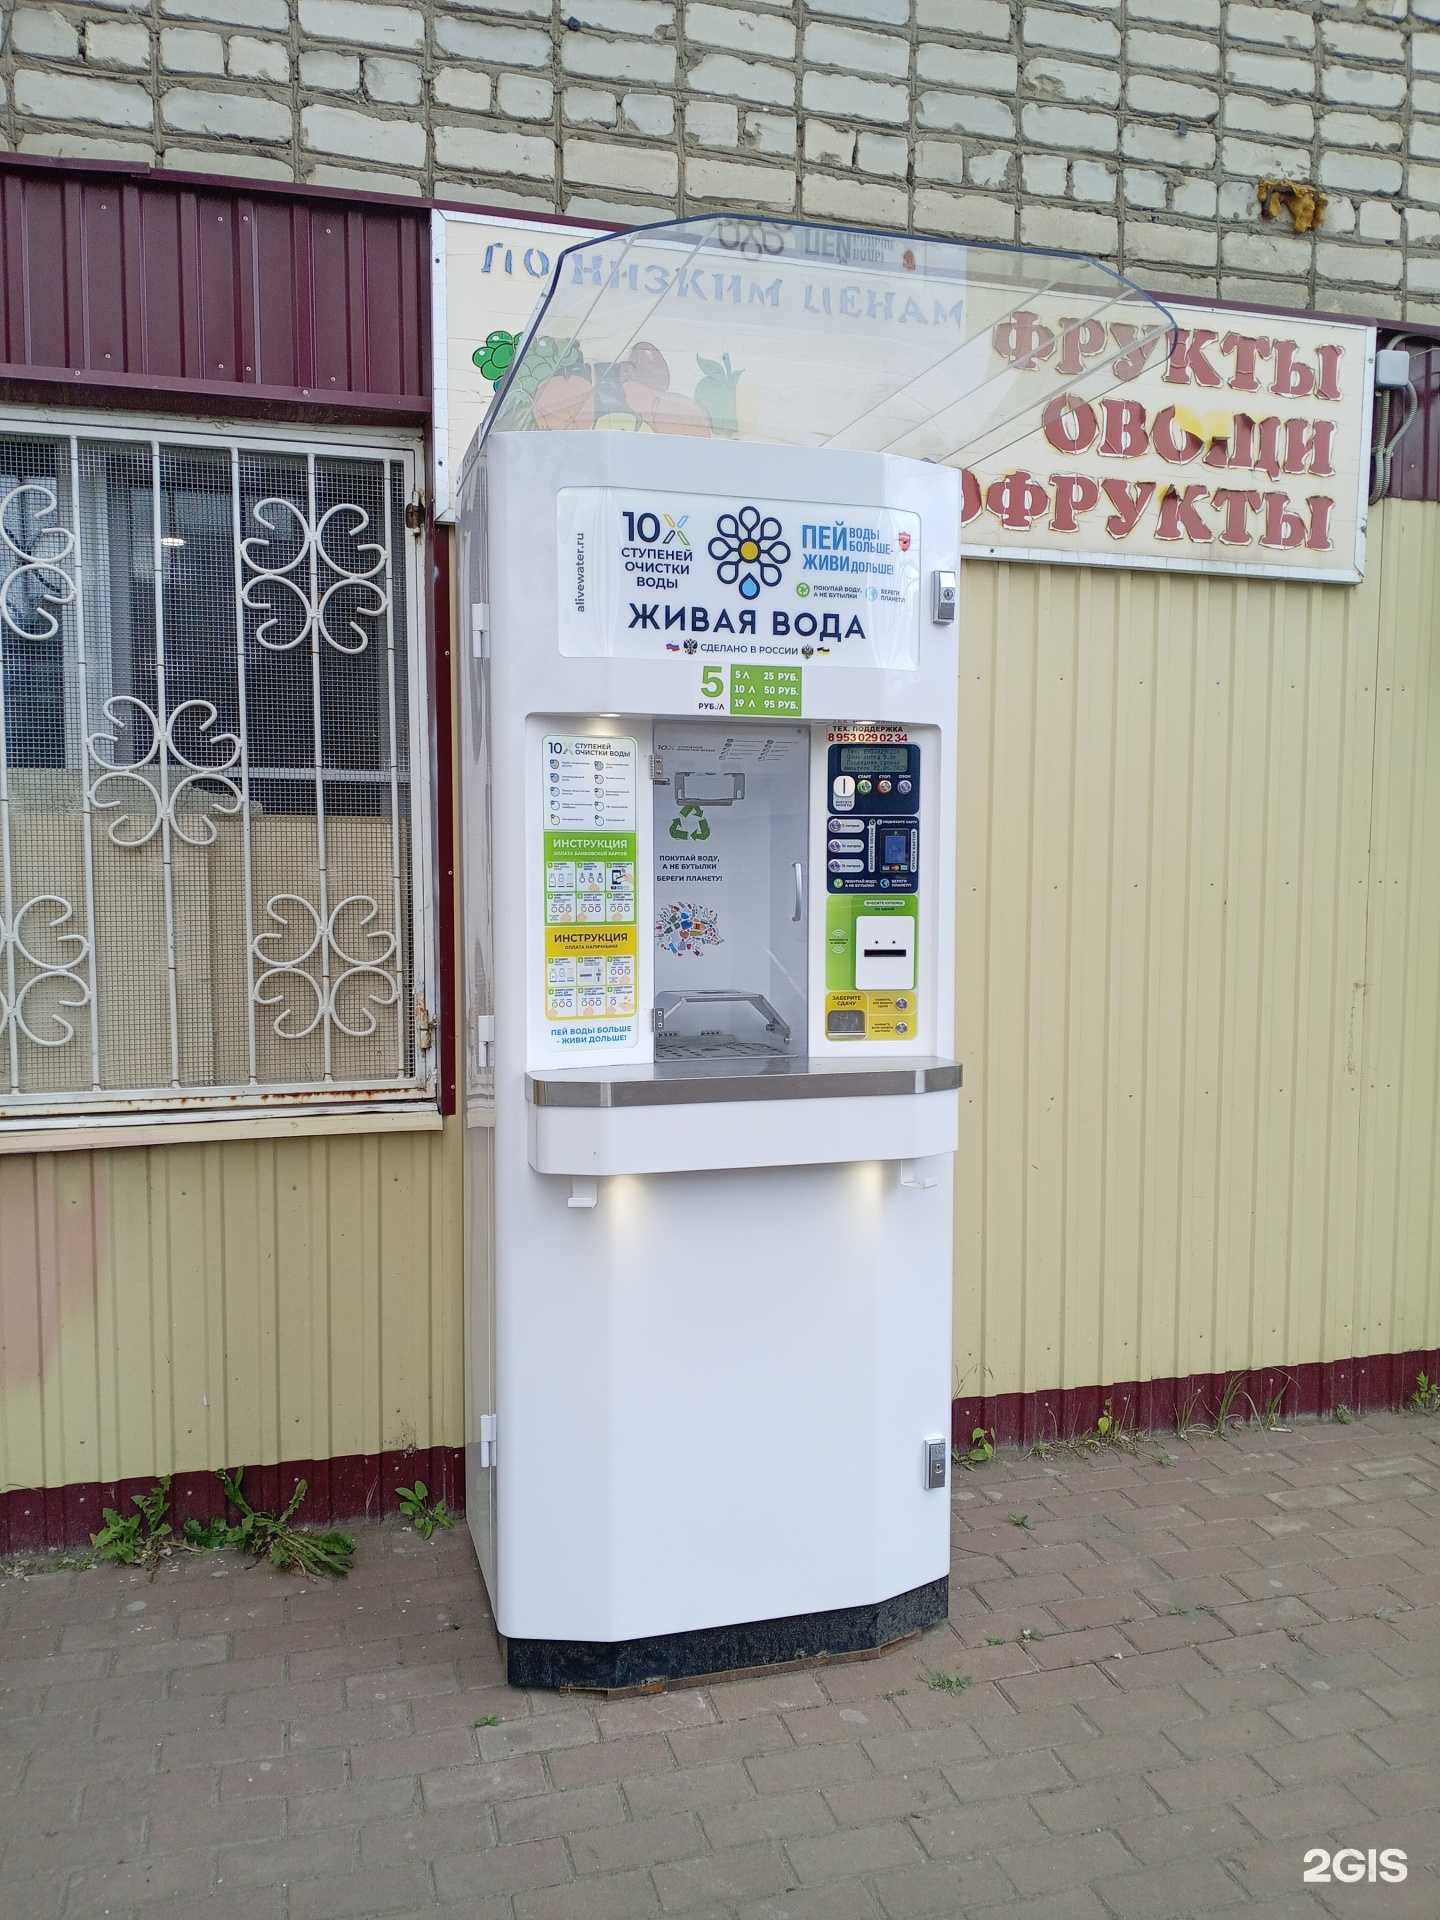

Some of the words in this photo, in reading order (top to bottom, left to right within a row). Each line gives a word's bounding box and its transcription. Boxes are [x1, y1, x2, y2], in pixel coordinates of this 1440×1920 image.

[481, 242, 549, 278] ПО
[571, 253, 783, 306] НИЗКИМ
[802, 283, 964, 327] ЦЕНАМ
[993, 310, 1345, 401] ФРУКТЫ
[802, 521, 848, 551] ПЕЙ
[850, 527, 880, 541] ВОДЫ
[621, 547, 693, 561] СТУПЕНЕЙ
[625, 561, 690, 575] ОЧИСТКИ
[802, 554, 850, 572] ЖИВИ
[851, 561, 896, 575] ДОЛЬШЕ!
[575, 533, 585, 612] alivewater.ru
[636, 577, 678, 590] ВОДЫ
[813, 584, 844, 592] ПОКУПАЙ
[829, 592, 858, 600] БУТЫЛКИ
[628, 603, 756, 635] ЖИВАЯ
[772, 611, 866, 642] ВОДА
[700, 643, 748, 653] СДЕЛАНО
[751, 645, 756, 653] В
[759, 646, 799, 655] РОССИИ
[700, 665, 725, 698] 5
[763, 672, 774, 680] 25
[777, 673, 799, 682] РУБ.
[735, 685, 745, 693] 10
[764, 686, 775, 695] 50
[777, 687, 799, 696] РУБ.
[735, 699, 745, 707] 19
[764, 700, 775, 709] 95
[777, 701, 799, 710] РУБ.
[853, 725, 903, 733] ПОДДЕРЖКА
[836, 733, 856, 742] 953
[858, 733, 878, 742] 029
[880, 733, 893, 742] 02
[894, 733, 908, 742] 34
[575, 749, 608, 757] ОЧИСТКИ
[553, 839, 628, 850] ИНСТРУКЦИЯ
[659, 854, 696, 862] ПОКУПАЙ
[698, 855, 720, 863] ВОДУ,
[554, 933, 628, 943] ИНСТРУКЦИЯ
[551, 1027, 568, 1036] ПЕЙ
[570, 1027, 595, 1036] ВОДЫ
[597, 1025, 632, 1034] БОЛЬШЕ
[561, 1036, 587, 1045] ЖИВИ
